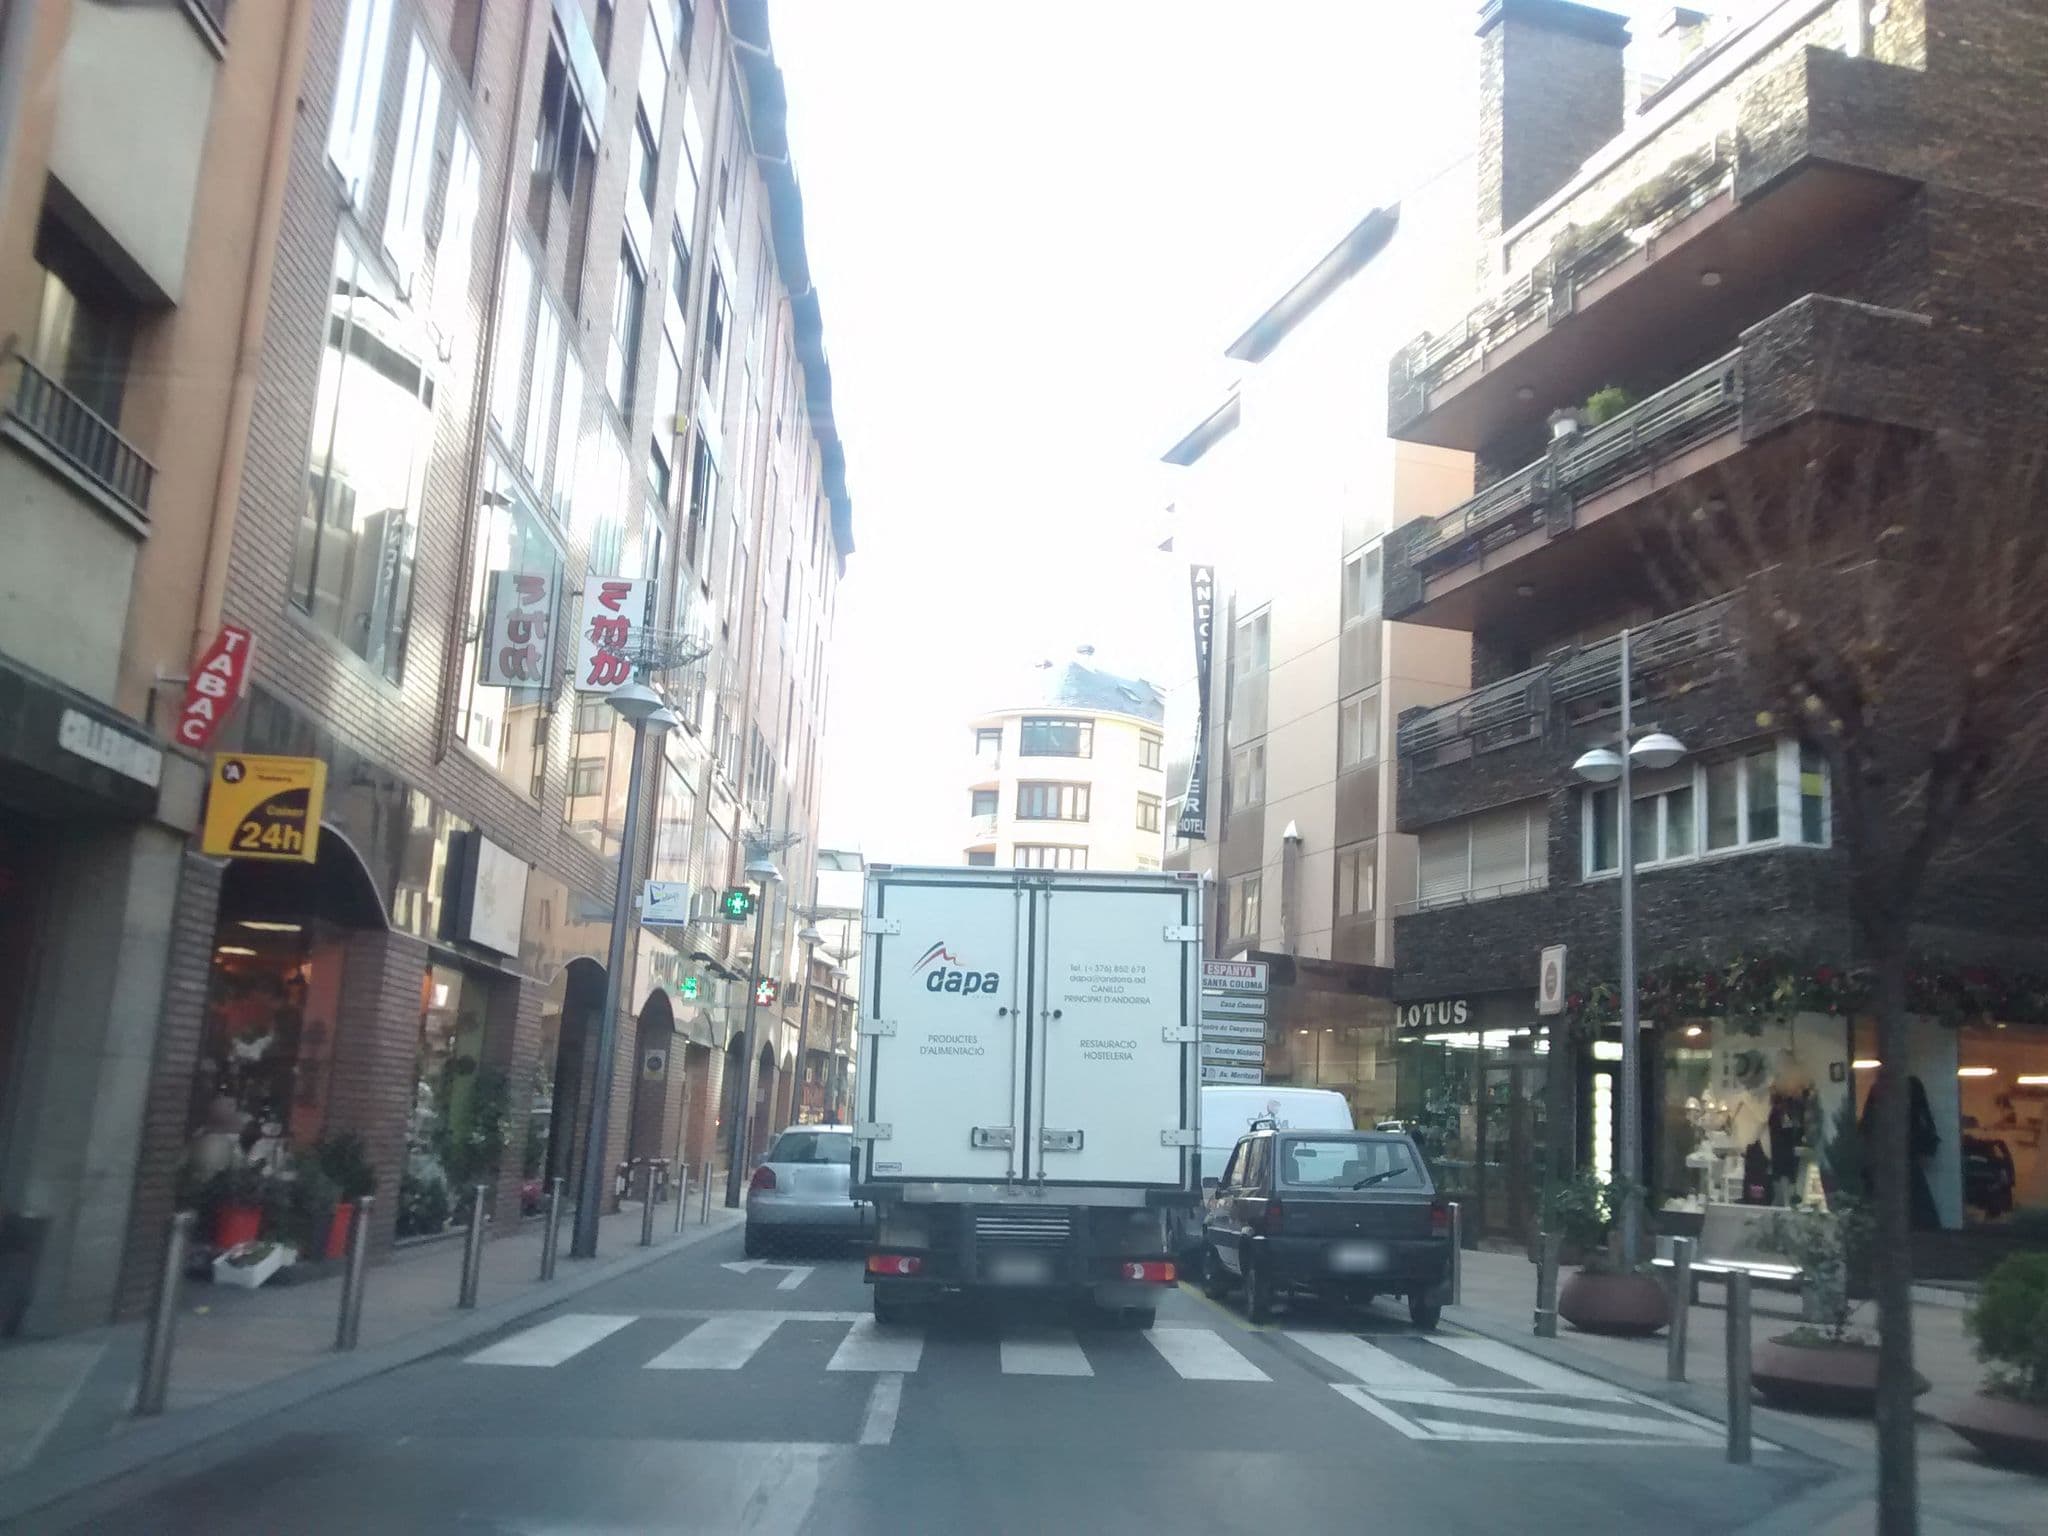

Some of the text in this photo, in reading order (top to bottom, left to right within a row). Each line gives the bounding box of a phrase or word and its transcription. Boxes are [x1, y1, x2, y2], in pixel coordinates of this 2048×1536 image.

[181, 629, 245, 741] TABAC
[238, 820, 303, 851] 24h
[1206, 963, 1253, 977] ESPANYA
[926, 966, 1000, 996] dapa
[1202, 978, 1263, 990] SANTA COLOMA
[1091, 985, 1124, 994] CANILLO
[1063, 995, 1102, 1004] PRINCIPAT
[1396, 1000, 1468, 1028] LOTUS
[927, 1034, 978, 1044] PRODUCTES
[1084, 1051, 1134, 1061] HOSTELERIA
